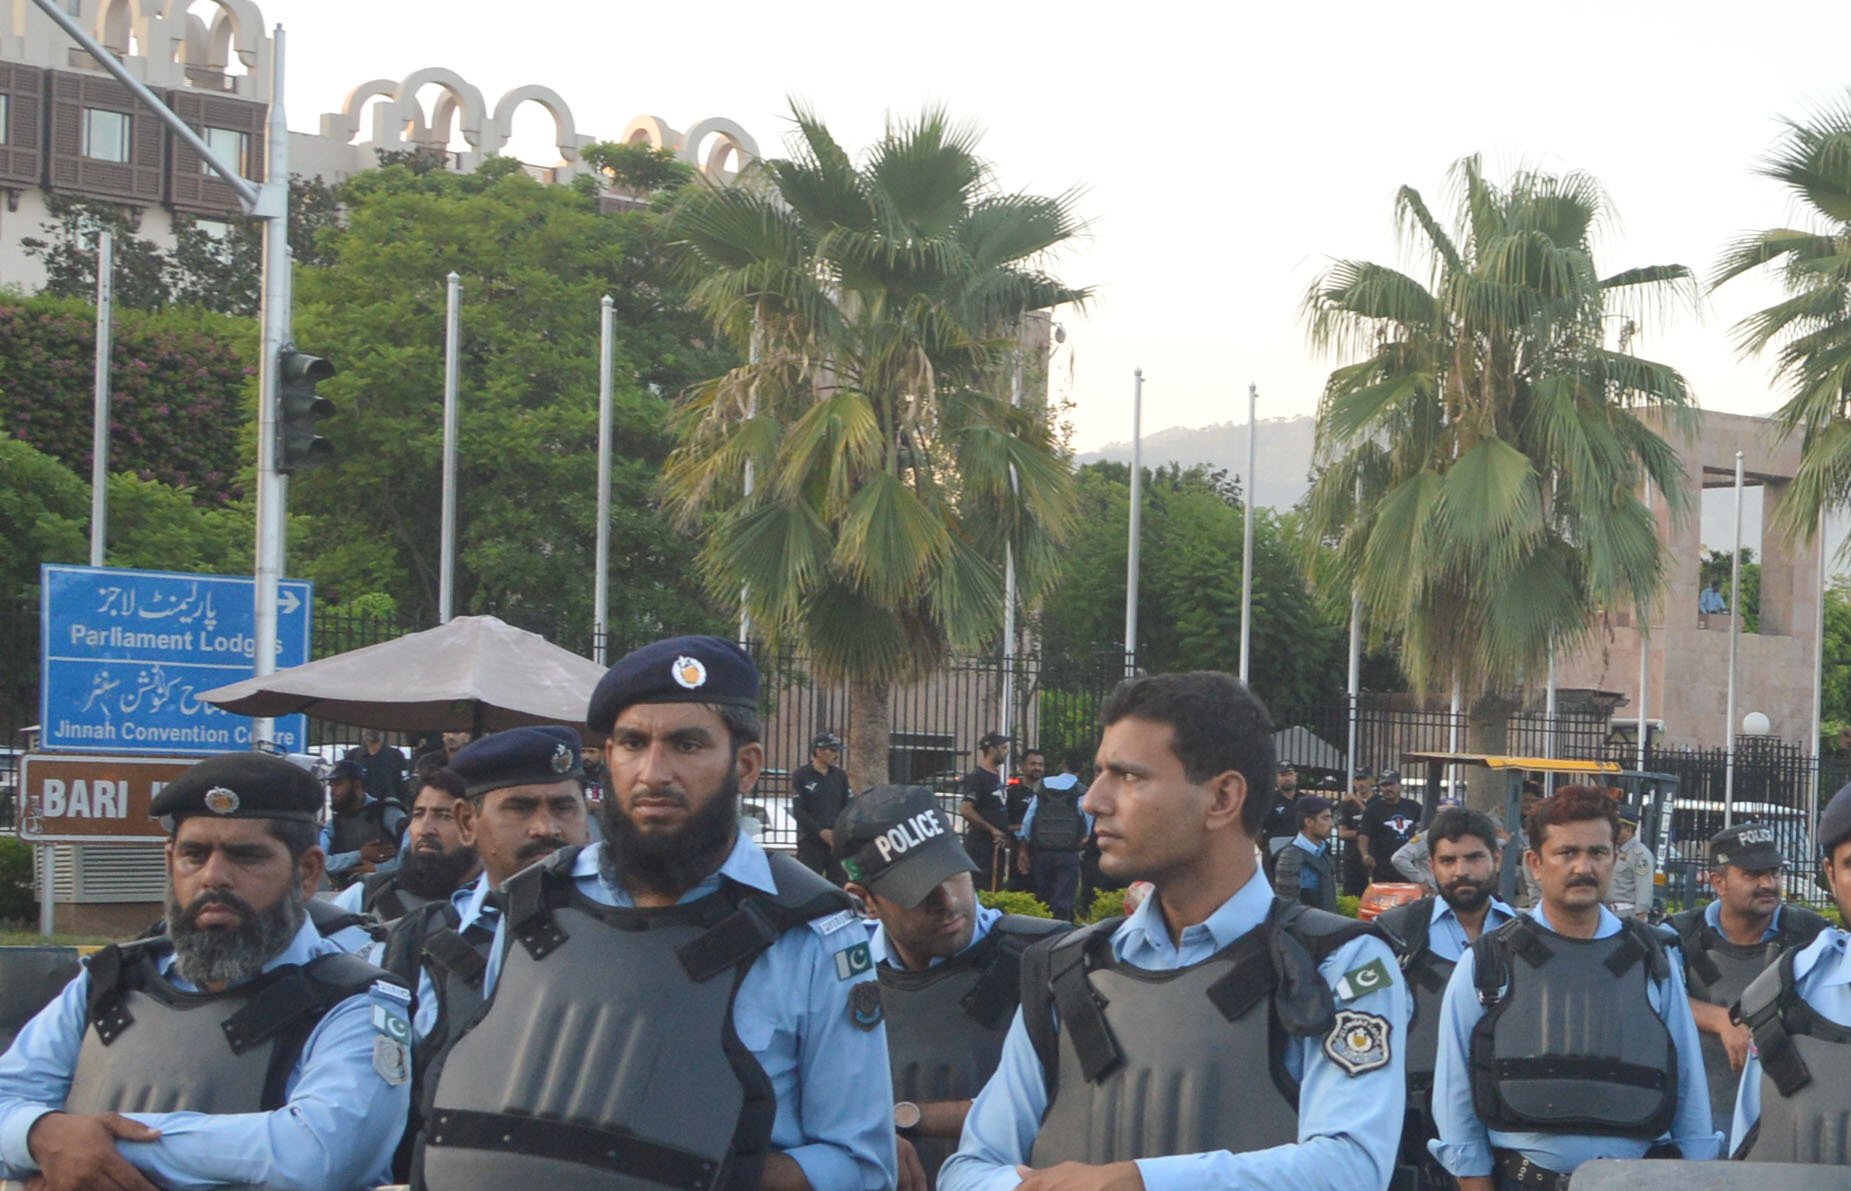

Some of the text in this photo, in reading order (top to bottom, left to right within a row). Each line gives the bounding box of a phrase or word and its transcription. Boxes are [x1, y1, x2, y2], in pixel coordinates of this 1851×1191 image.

[97, 586, 136, 617] لاجز
[71, 624, 283, 658] Parliament Lodgs
[54, 720, 116, 741] Jinnah
[121, 721, 231, 744] Convention
[43, 779, 128, 818] BARI
[874, 808, 944, 862] POLICE
